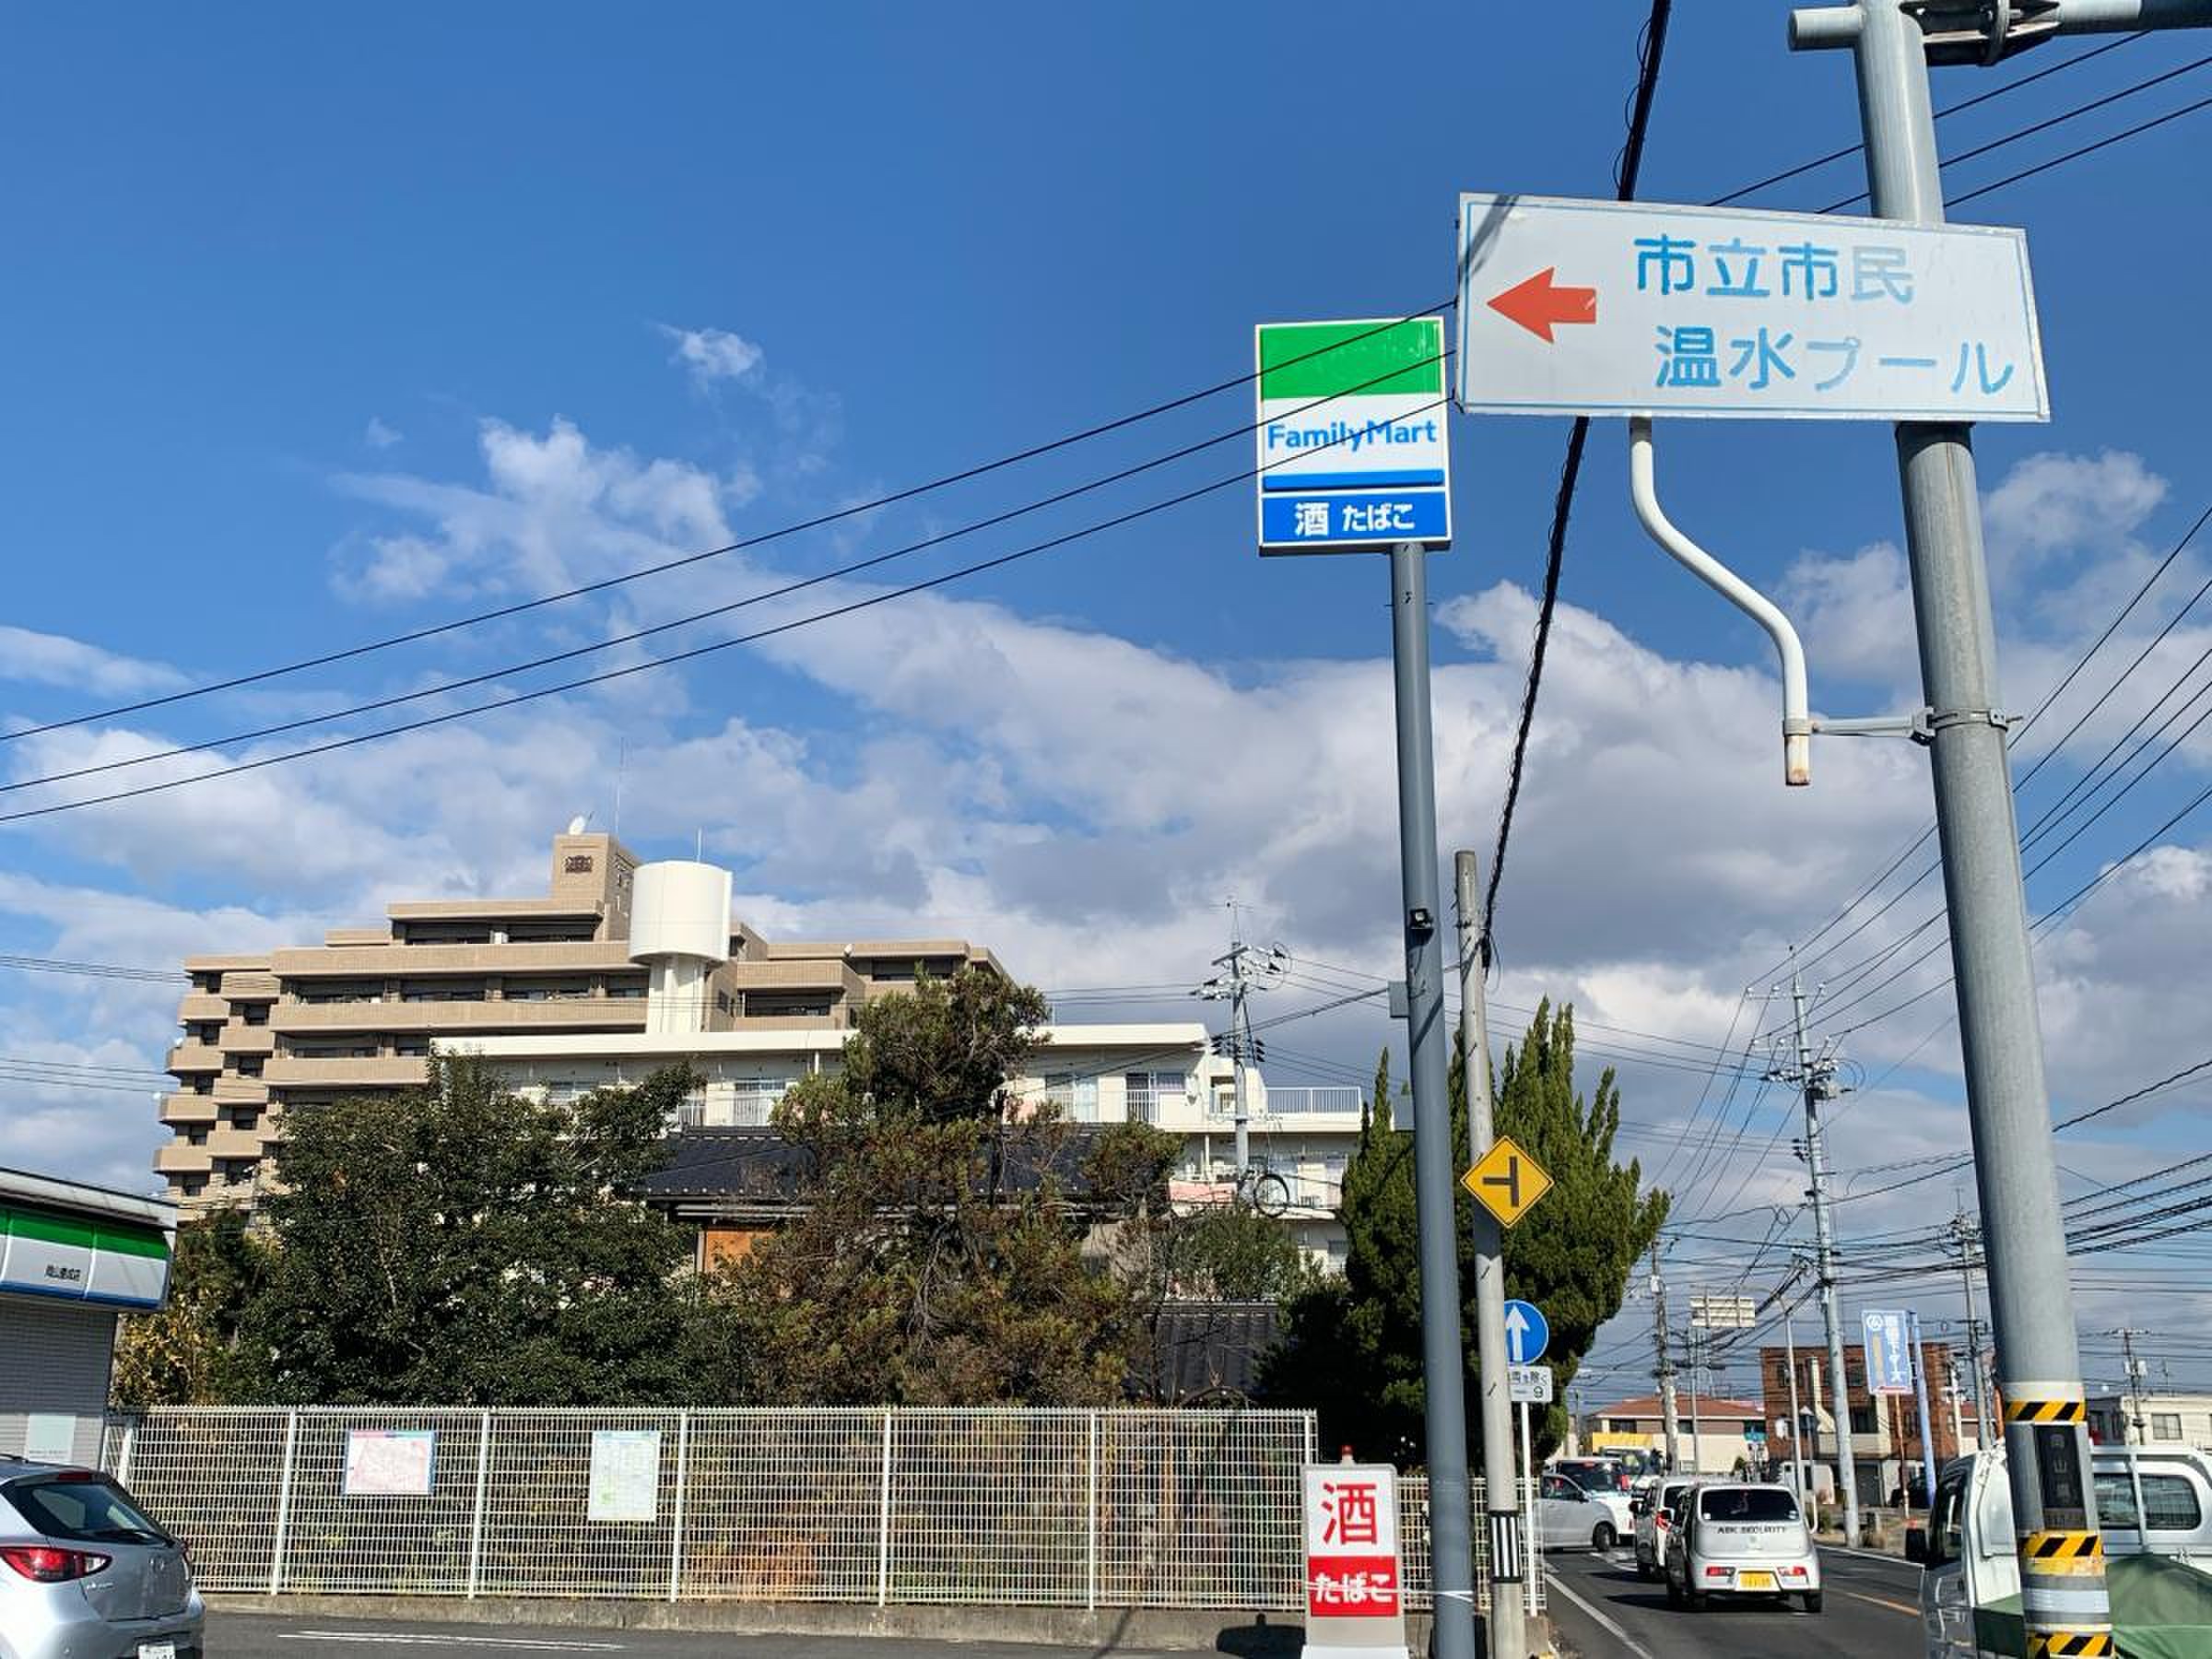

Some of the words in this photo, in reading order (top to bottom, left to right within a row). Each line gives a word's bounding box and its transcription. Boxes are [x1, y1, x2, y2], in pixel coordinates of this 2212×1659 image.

[1632, 233, 1915, 304] 市立市民
[1653, 324, 2015, 395] 温水プール
[1266, 419, 1438, 452] FamilyMart
[1294, 501, 1330, 536] 酒
[1342, 502, 1416, 532] たばこ
[1320, 1482, 1378, 1546] 酒
[1314, 1570, 1393, 1604] たばこ
